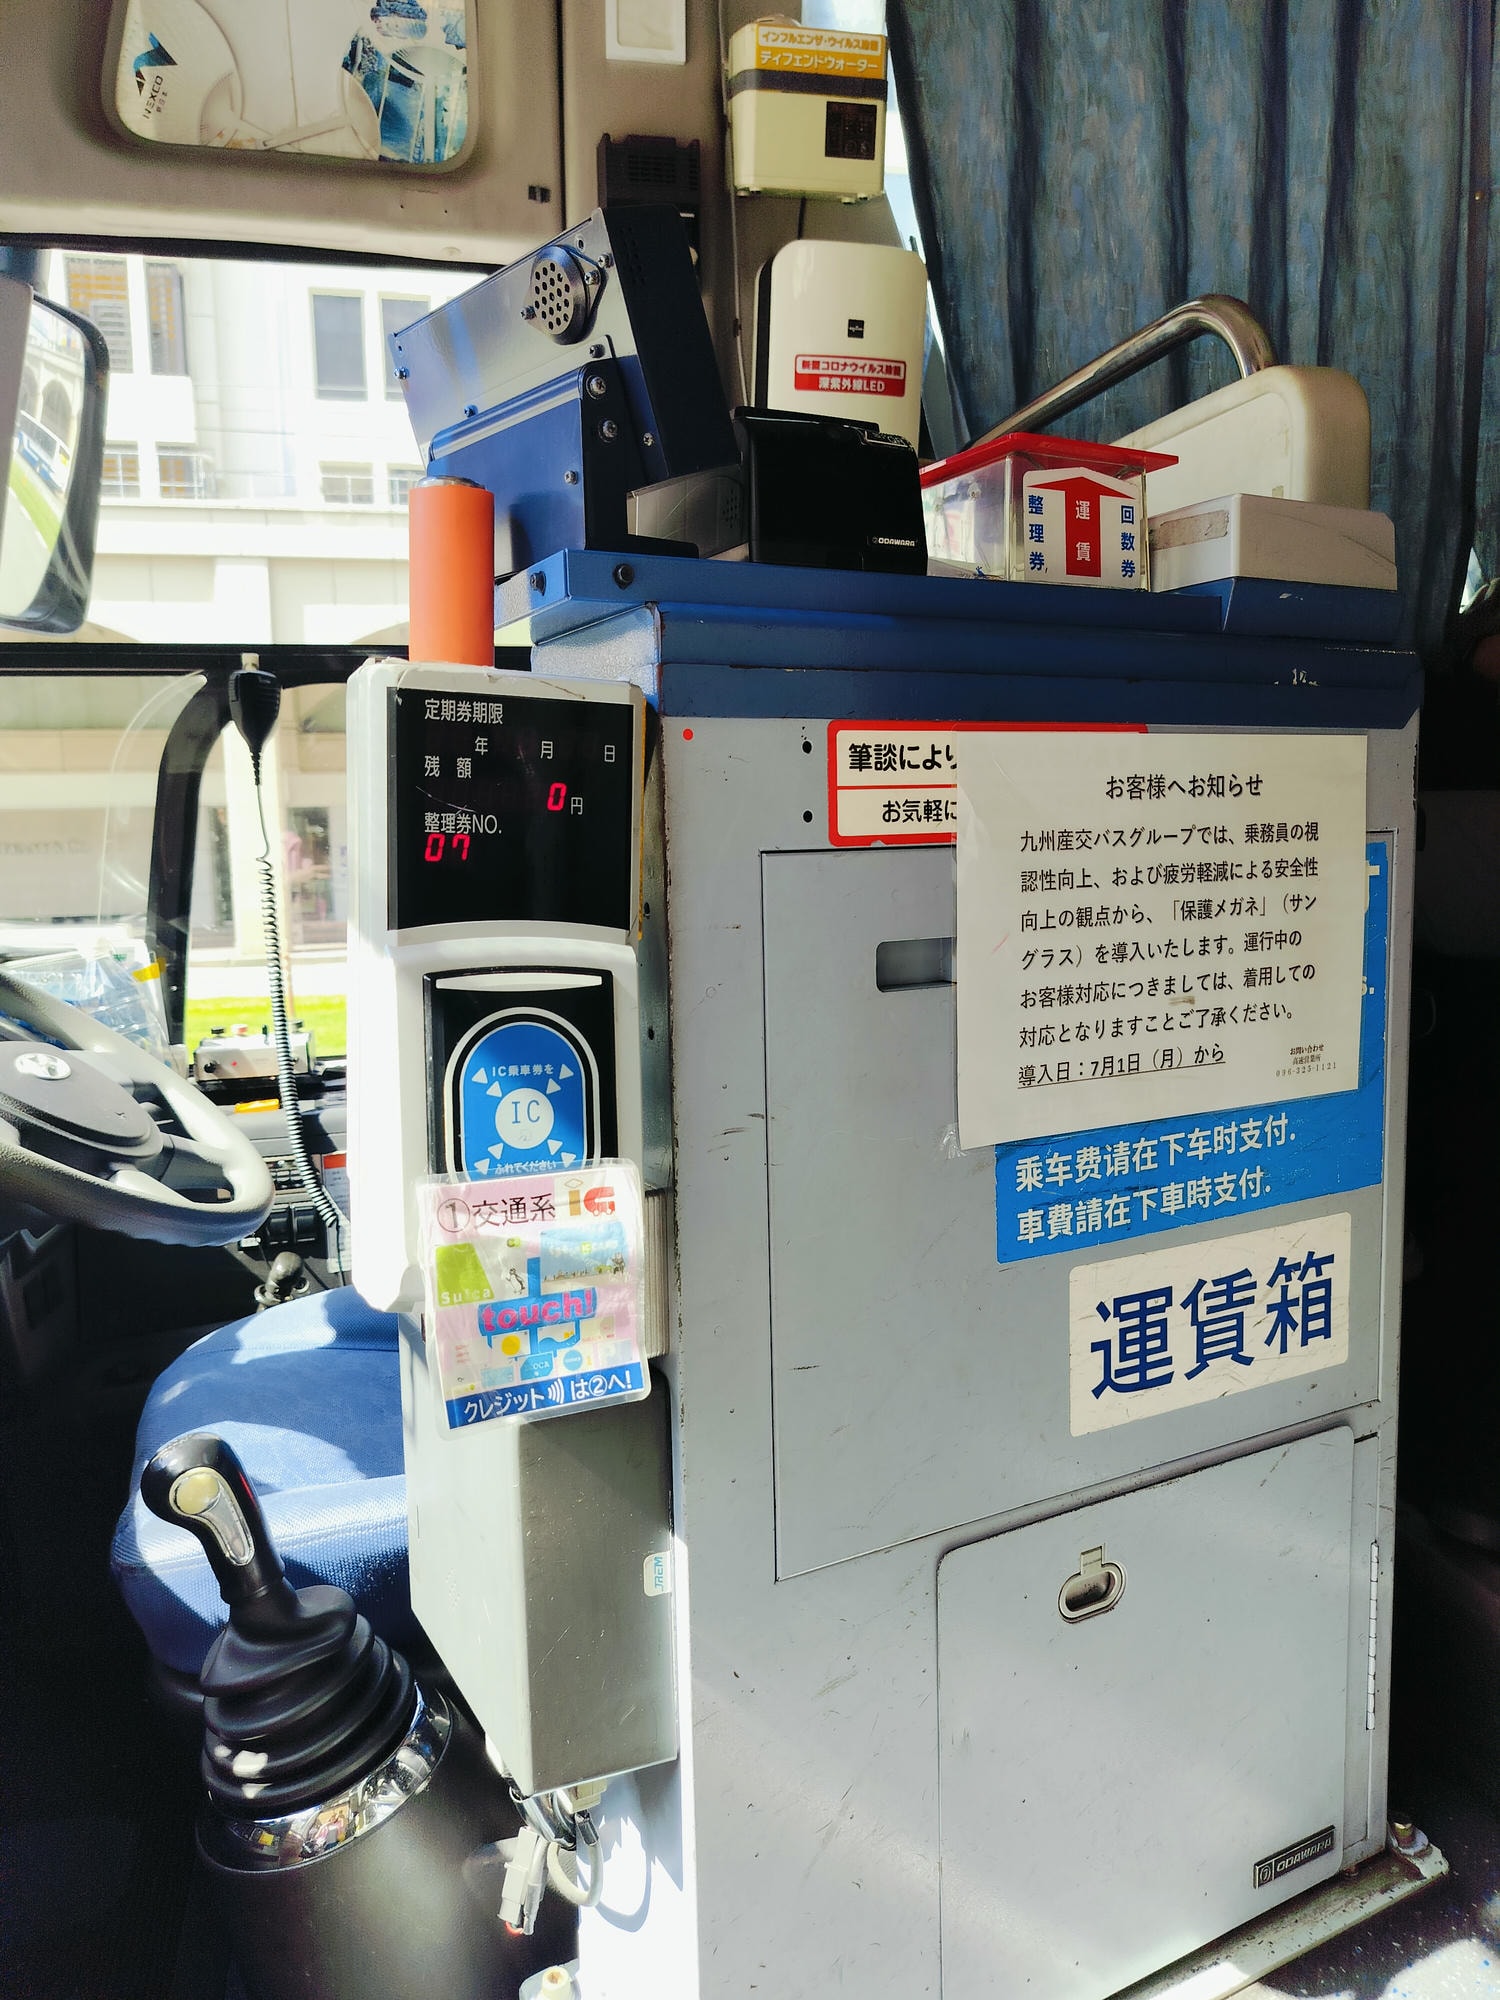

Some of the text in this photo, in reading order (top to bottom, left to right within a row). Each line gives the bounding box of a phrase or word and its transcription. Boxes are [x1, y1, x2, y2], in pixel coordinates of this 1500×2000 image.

[878, 537, 916, 547] ODAWARA
[1028, 494, 1045, 572] 整理券
[1075, 500, 1091, 562] 運賃
[1121, 504, 1136, 578] 回数券
[424, 698, 503, 724] 定期券期限
[474, 736, 616, 763] 年 月 日
[547, 782, 583, 816] 0 円
[1105, 774, 1264, 800] お客様へお知らせ
[424, 812, 502, 834] 整理券NO.
[1020, 821, 1319, 852] 九州産交バスグループでは、乗務員の視
[424, 834, 471, 862] 07
[1020, 857, 1319, 893] 認性向上、および疲労軽減による安全性
[1020, 964, 1316, 1009] お客様対応につきましては、着用しての
[1019, 1002, 1292, 1048] 対応となりますことご了承ください。
[492, 1063, 554, 1077] IC乗車券を
[481, 1288, 594, 1332] touch!
[1090, 1250, 1335, 1400] 運賃箱
[464, 1386, 545, 1424] クレジット
[1276, 1838, 1332, 1872] ODAWARA
